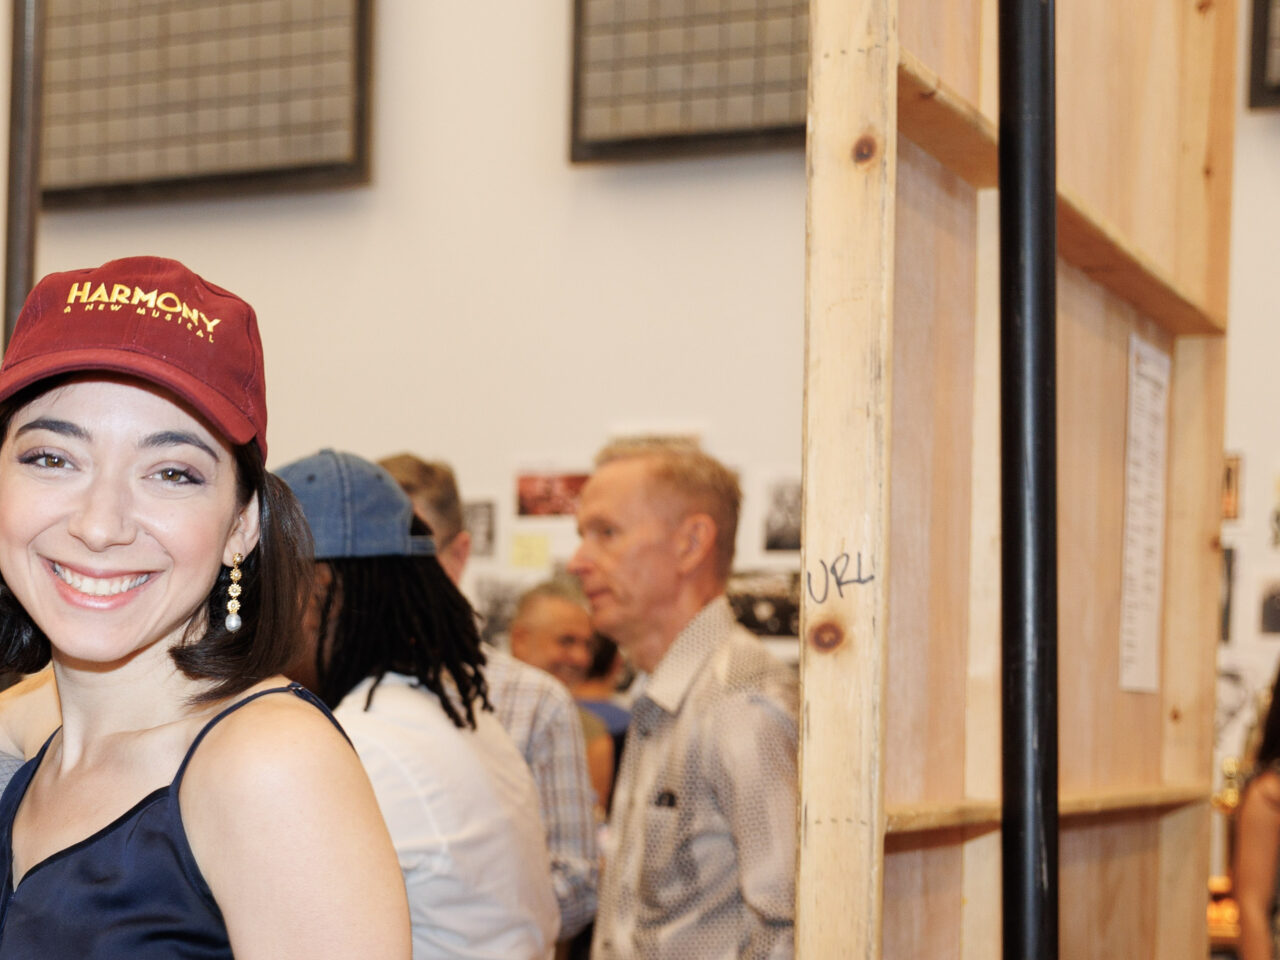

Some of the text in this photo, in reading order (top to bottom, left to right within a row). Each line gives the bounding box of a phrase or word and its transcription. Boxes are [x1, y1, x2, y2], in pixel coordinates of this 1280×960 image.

[63, 303, 214, 343] A NEW MUSICAL
[67, 282, 221, 332] HARMONY
[807, 551, 875, 604] URL
